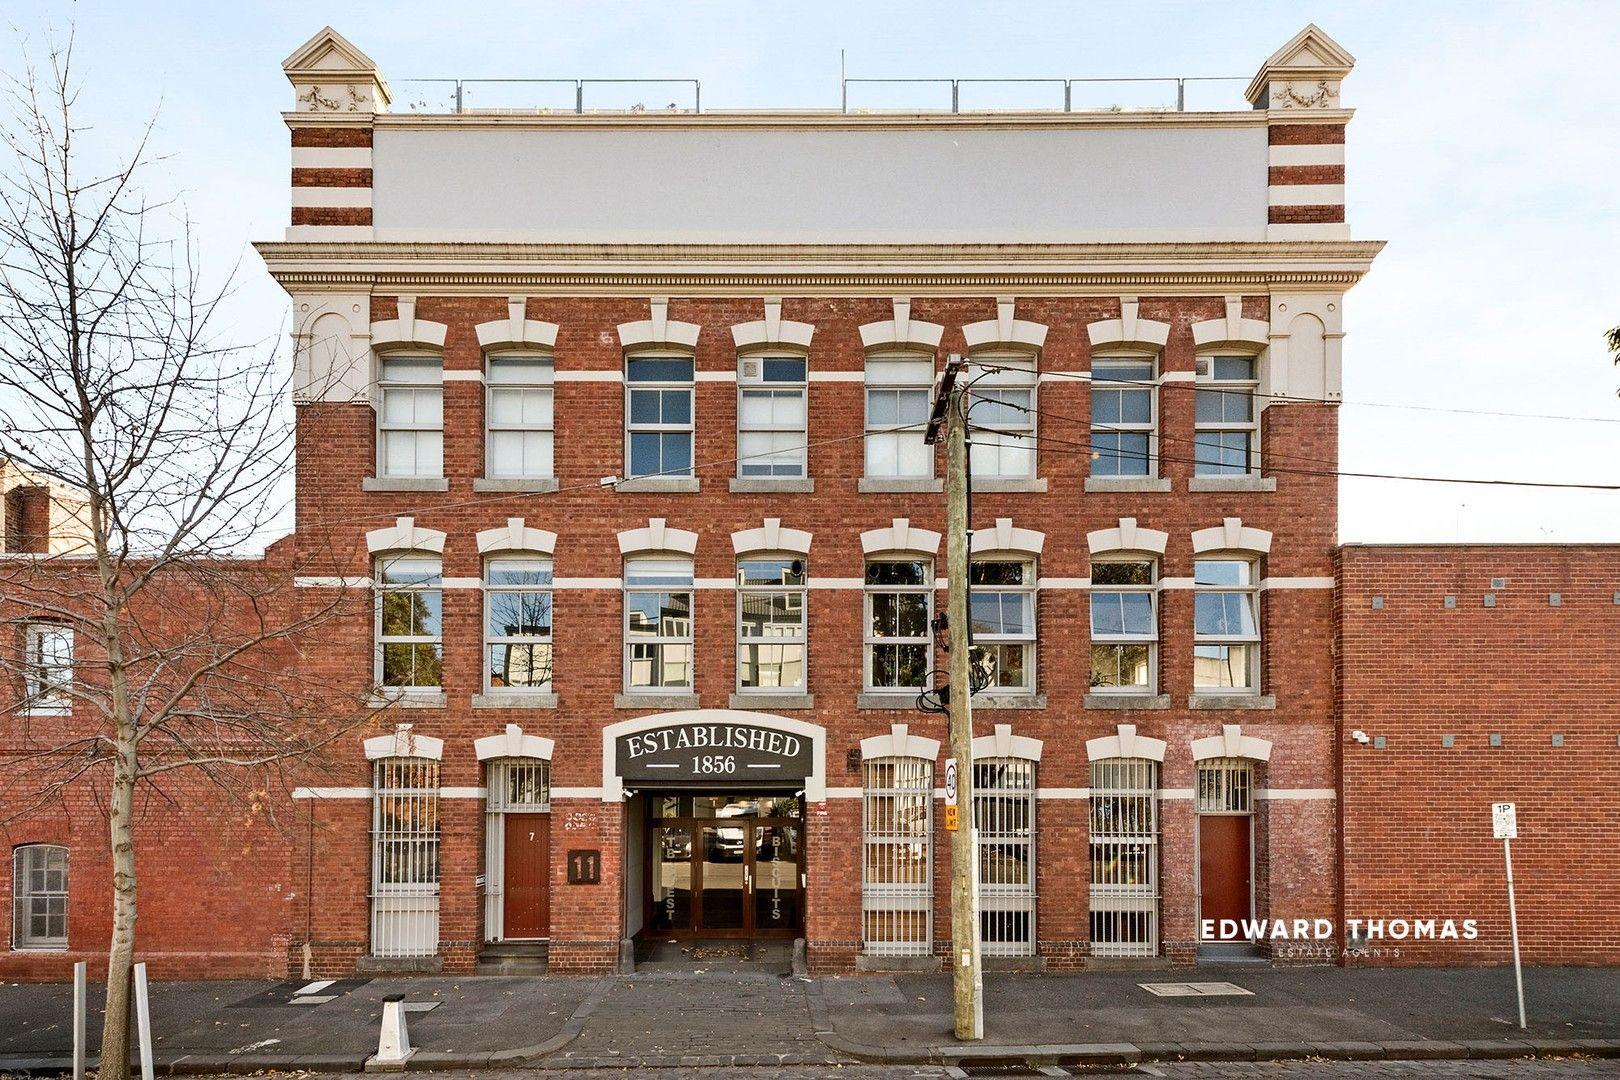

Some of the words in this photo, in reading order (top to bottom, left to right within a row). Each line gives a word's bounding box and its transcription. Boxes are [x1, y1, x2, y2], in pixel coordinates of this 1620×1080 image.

[626, 726, 801, 759] ESTABLISHED
[692, 755, 736, 774] 1856
[1497, 804, 1511, 813] 1P
[529, 832, 535, 841] 7
[573, 856, 596, 880] 11
[772, 837, 781, 920] BISCUITS
